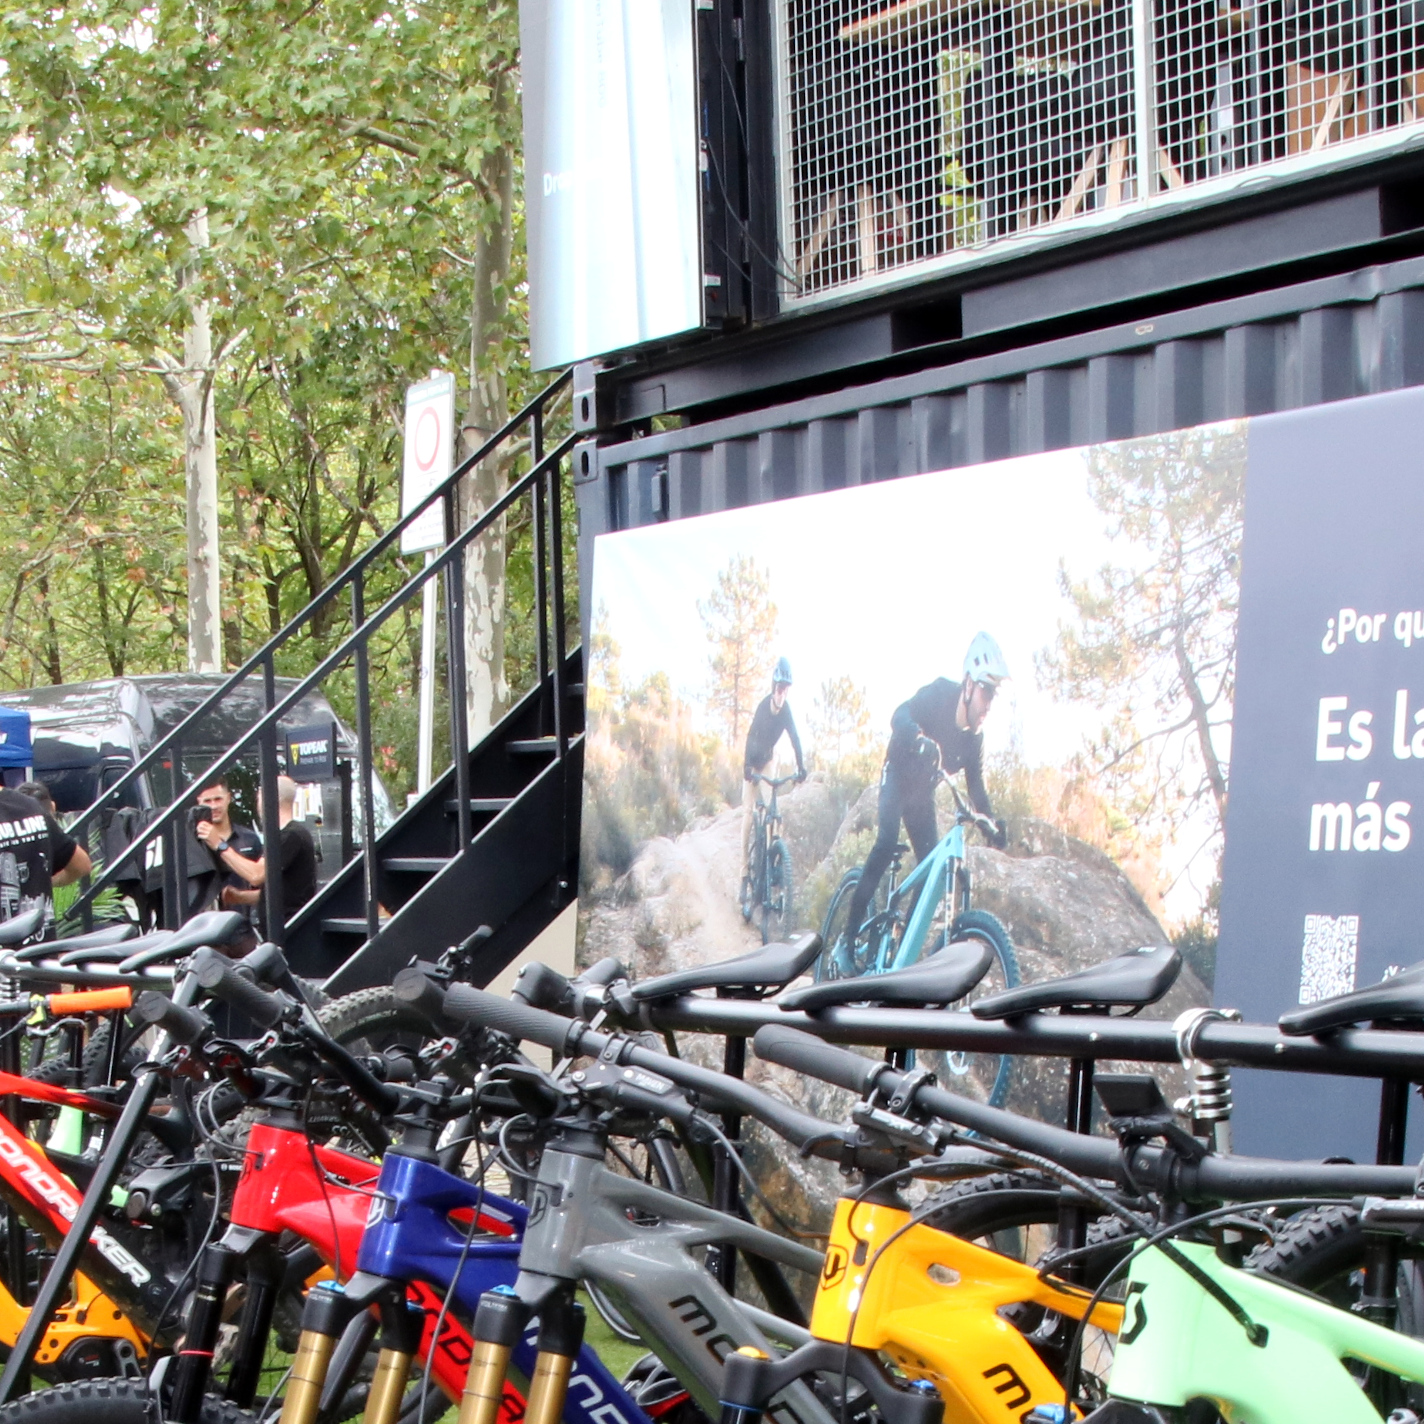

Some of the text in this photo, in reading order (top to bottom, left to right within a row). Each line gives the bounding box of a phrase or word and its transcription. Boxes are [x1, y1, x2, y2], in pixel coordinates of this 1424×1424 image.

[1321, 607, 1386, 654] ¿Por
[299, 739, 328, 755] TOPEAK
[1315, 695, 1373, 761] Es
[14, 815, 48, 837] LINE
[1309, 781, 1411, 852] más
